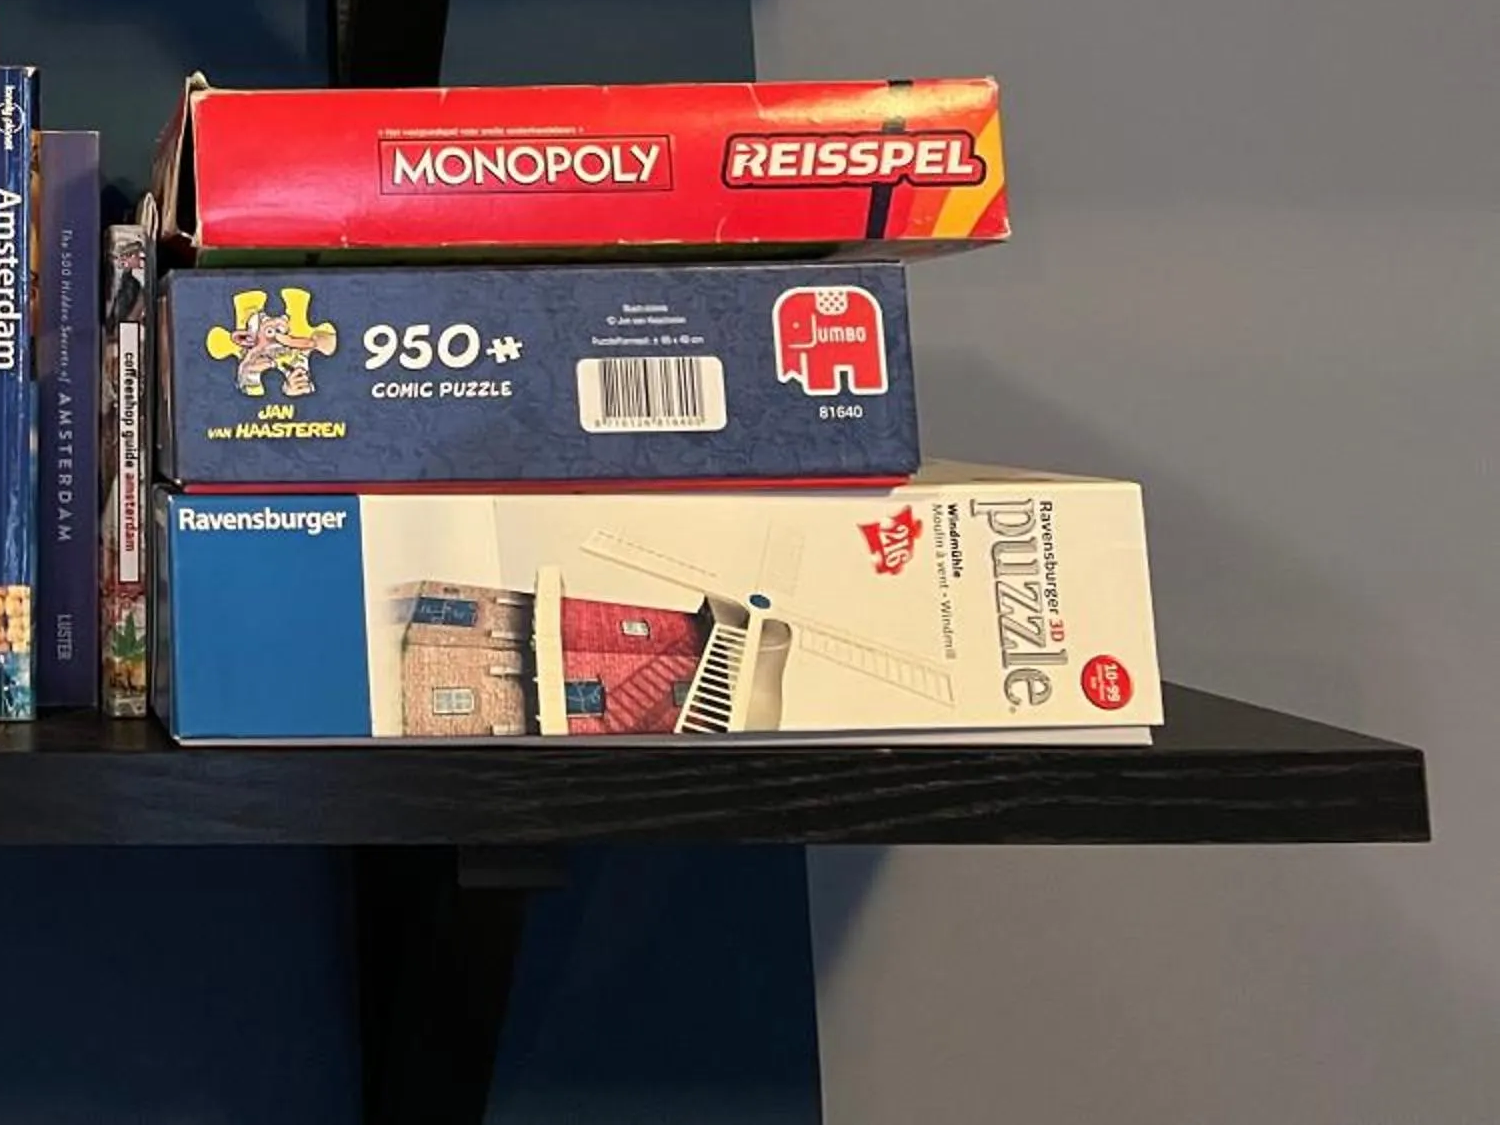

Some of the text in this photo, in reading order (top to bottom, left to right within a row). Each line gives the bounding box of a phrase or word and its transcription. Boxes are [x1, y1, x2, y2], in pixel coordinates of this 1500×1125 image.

[392, 144, 660, 186] MONOPOLY
[730, 140, 975, 179] REISSPEL
[60, 230, 73, 249] The
[60, 252, 73, 277] 500
[59, 280, 73, 322] Hidden
[59, 324, 73, 367] Secrets
[362, 323, 481, 370] 950
[371, 381, 513, 399] COMIC PUZZLE
[235, 422, 347, 439] HAASTEREN
[257, 404, 294, 421] JAN
[819, 405, 864, 419] 81640
[57, 392, 75, 543] AMSTERDAM
[121, 352, 139, 553] coffeeshop guide amsterdam
[178, 507, 347, 535] Ravensburger
[931, 503, 944, 549] Moulin
[946, 503, 964, 579] Windmühle
[879, 524, 910, 568] 216
[936, 560, 949, 590] vent
[1039, 500, 1065, 643] Ravensburger 3D
[970, 499, 1068, 705] puzzle
